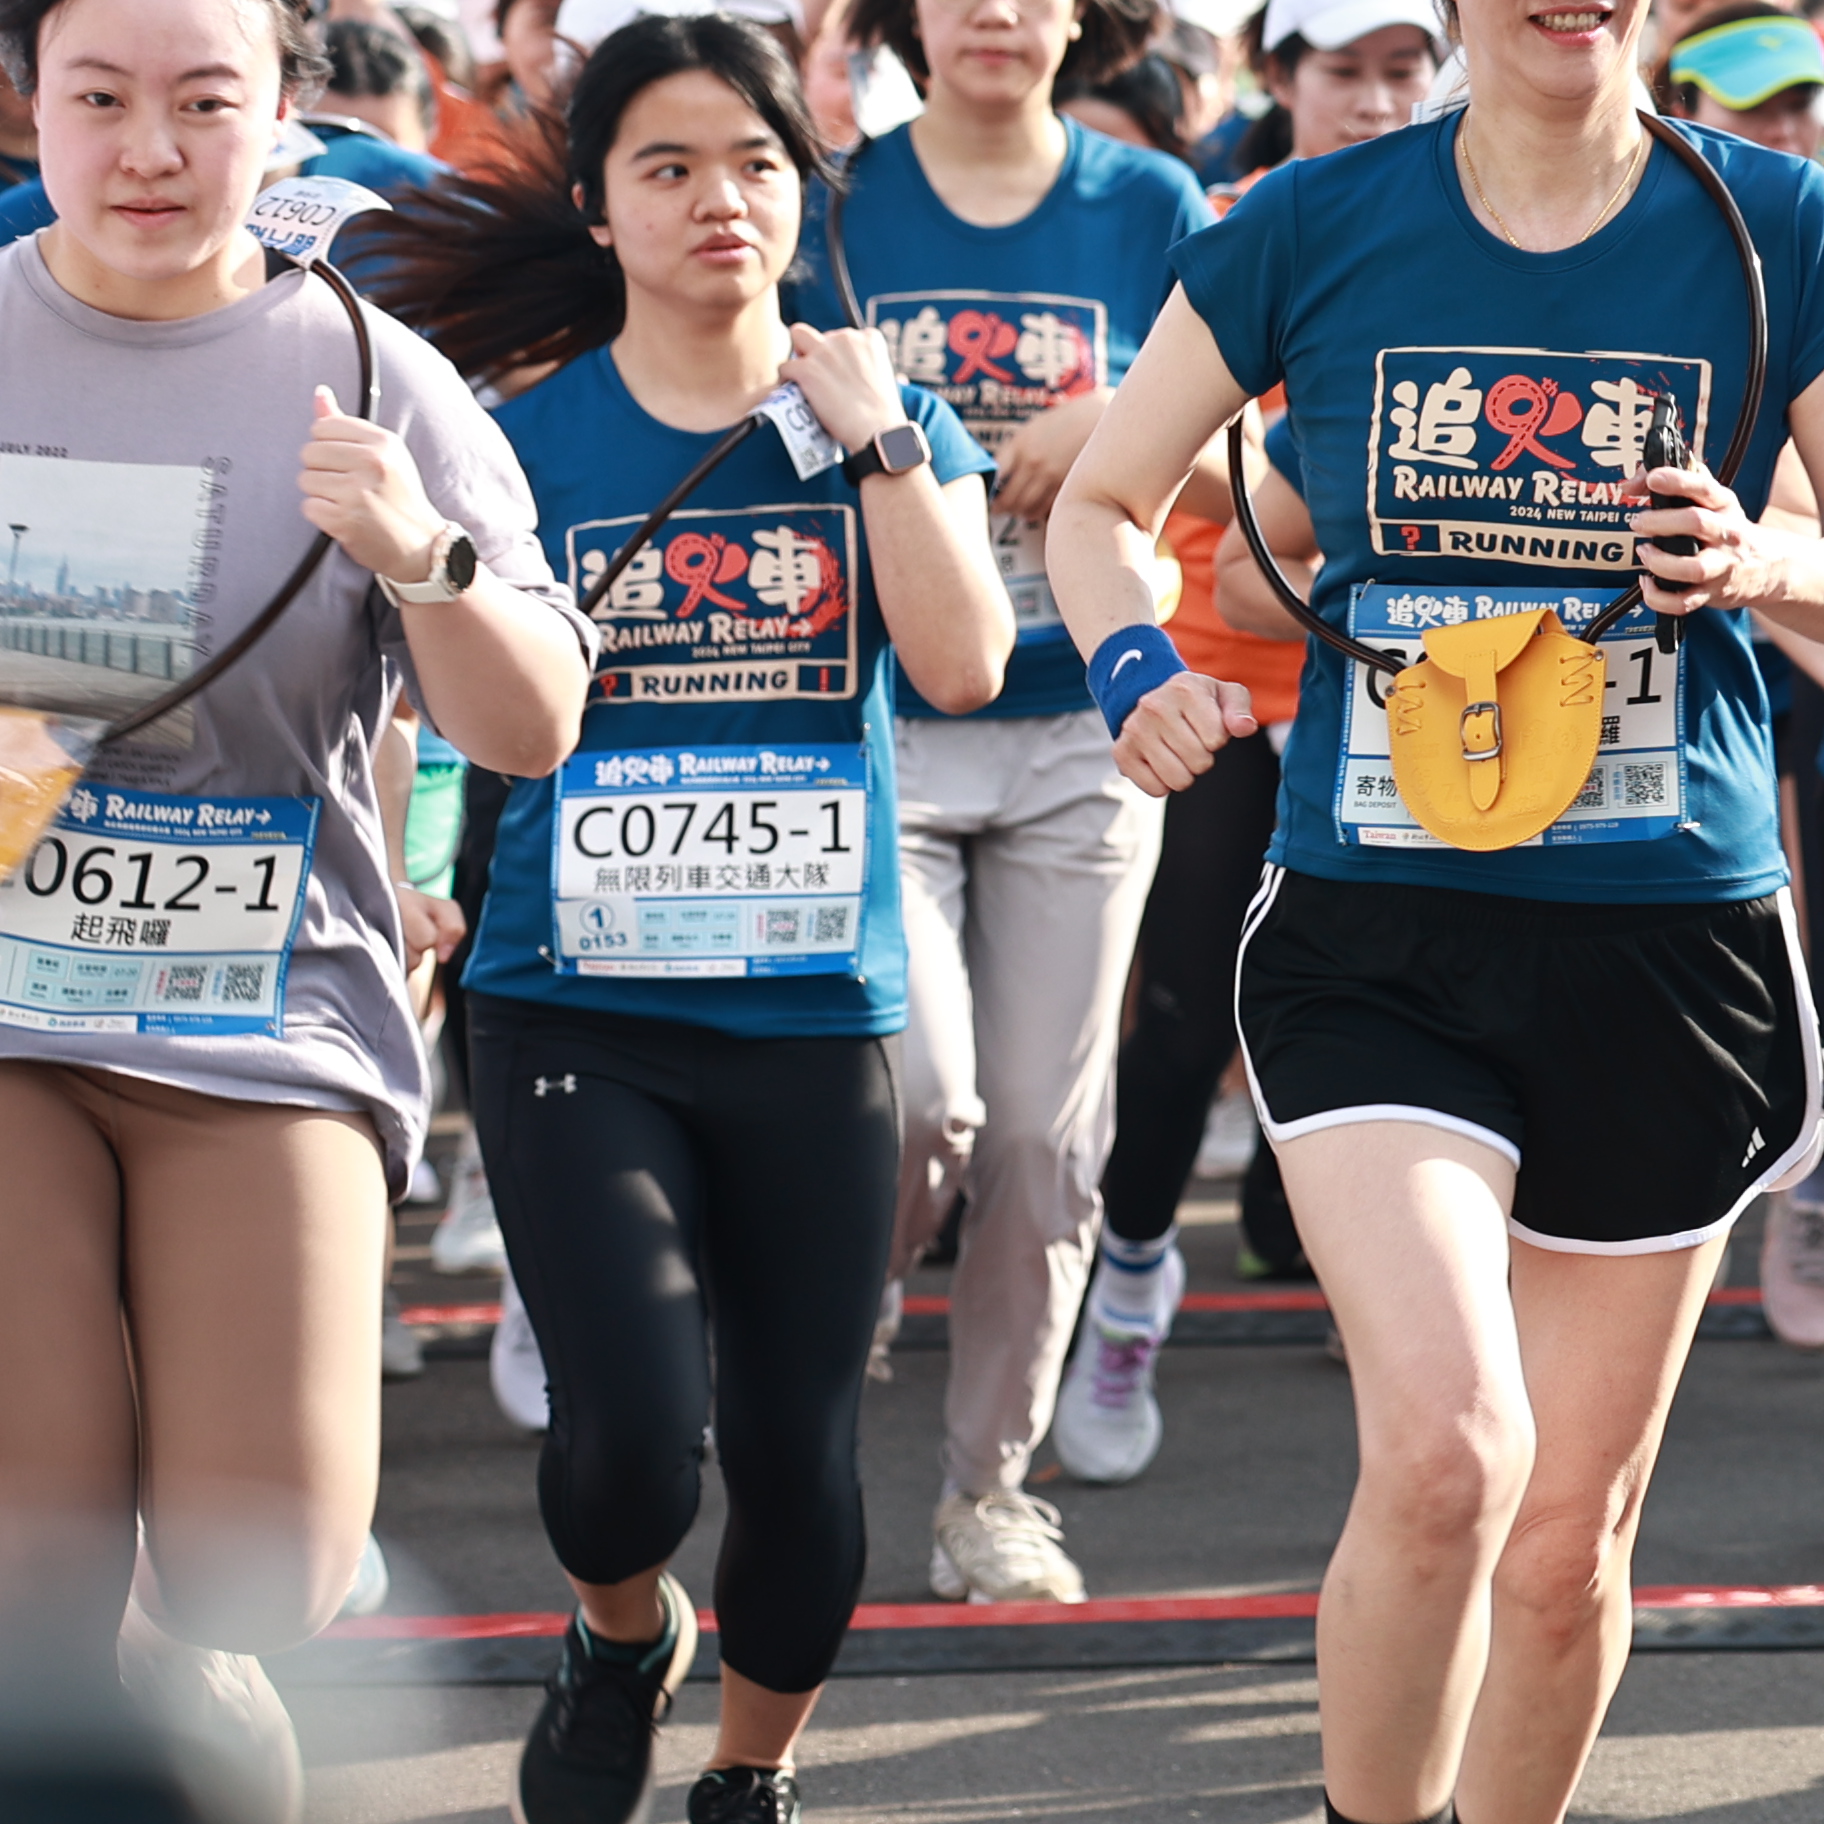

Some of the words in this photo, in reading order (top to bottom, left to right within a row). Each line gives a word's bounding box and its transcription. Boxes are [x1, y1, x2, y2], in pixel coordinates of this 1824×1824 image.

[254, 195, 337, 226] C0612
[1393, 464, 1524, 502] RAILWAY
[1532, 470, 1624, 507] RELAY
[1509, 504, 1542, 520] 2024
[1547, 507, 1577, 522] NEW
[1580, 509, 1620, 523] TAIPEI
[1449, 531, 1625, 563] RUNNING
[641, 670, 790, 696] RUNNING
[678, 752, 758, 776] RAILWAY
[759, 750, 816, 775] RELAY
[1356, 775, 1398, 798] 寄物
[105, 793, 194, 825] RAILWAY
[197, 802, 255, 828] RELAY
[572, 800, 851, 859] C0745-1
[4, 836, 279, 912] 0612-1
[594, 862, 831, 892] 無限列車交通大隊
[70, 912, 172, 947] 起飛囉
[578, 932, 629, 952] 0153
